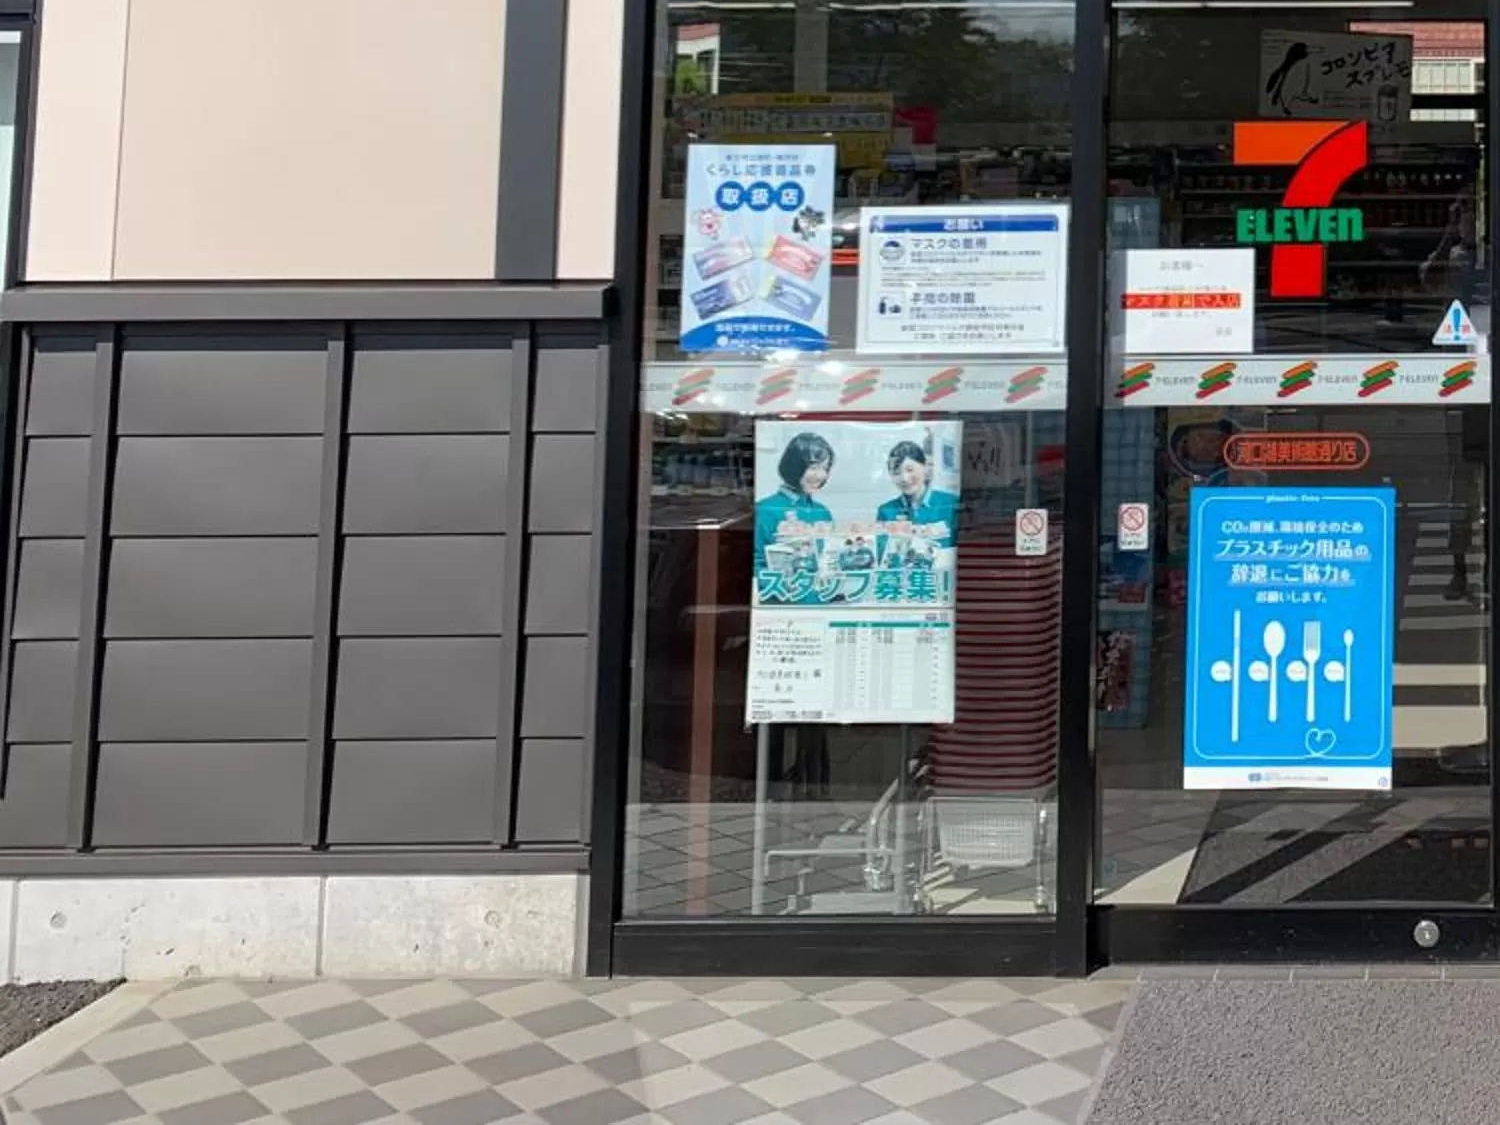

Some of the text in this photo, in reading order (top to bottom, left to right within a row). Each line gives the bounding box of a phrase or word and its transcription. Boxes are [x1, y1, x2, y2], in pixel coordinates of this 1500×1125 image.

[1321, 41, 1396, 76] コロンビア
[1217, 538, 1370, 559] プラスチック用品の
[1231, 563, 1352, 584] 辞退にご協力を
